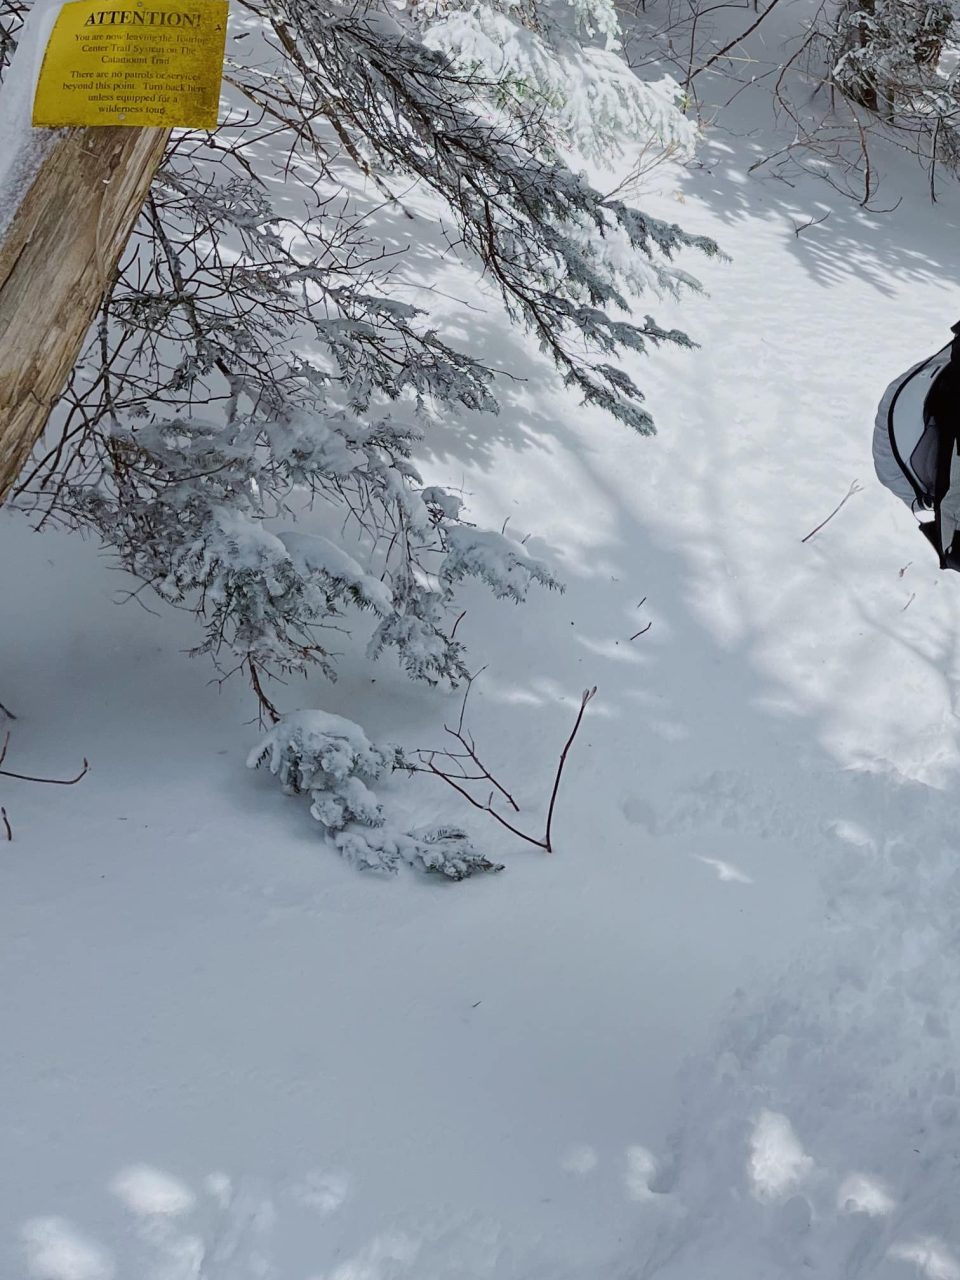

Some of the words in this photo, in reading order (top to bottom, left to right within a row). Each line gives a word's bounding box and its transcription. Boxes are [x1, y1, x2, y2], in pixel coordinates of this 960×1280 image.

[85, 10, 201, 27] ATTENTION!
[75, 33, 90, 43] You
[91, 34, 104, 42] are
[81, 44, 109, 53] Center
[111, 44, 132, 53] Trail
[101, 55, 148, 65] Catamount
[71, 70, 95, 79] There
[124, 71, 153, 81] patrols
[62, 82, 94, 92] beyond
[95, 82, 112, 91] this
[143, 83, 163, 91] Turn
[164, 83, 185, 92] back
[87, 94, 114, 102] unless
[116, 94, 156, 104] equipped
[158, 94, 170, 103] for
[98, 106, 143, 114] wilderness
